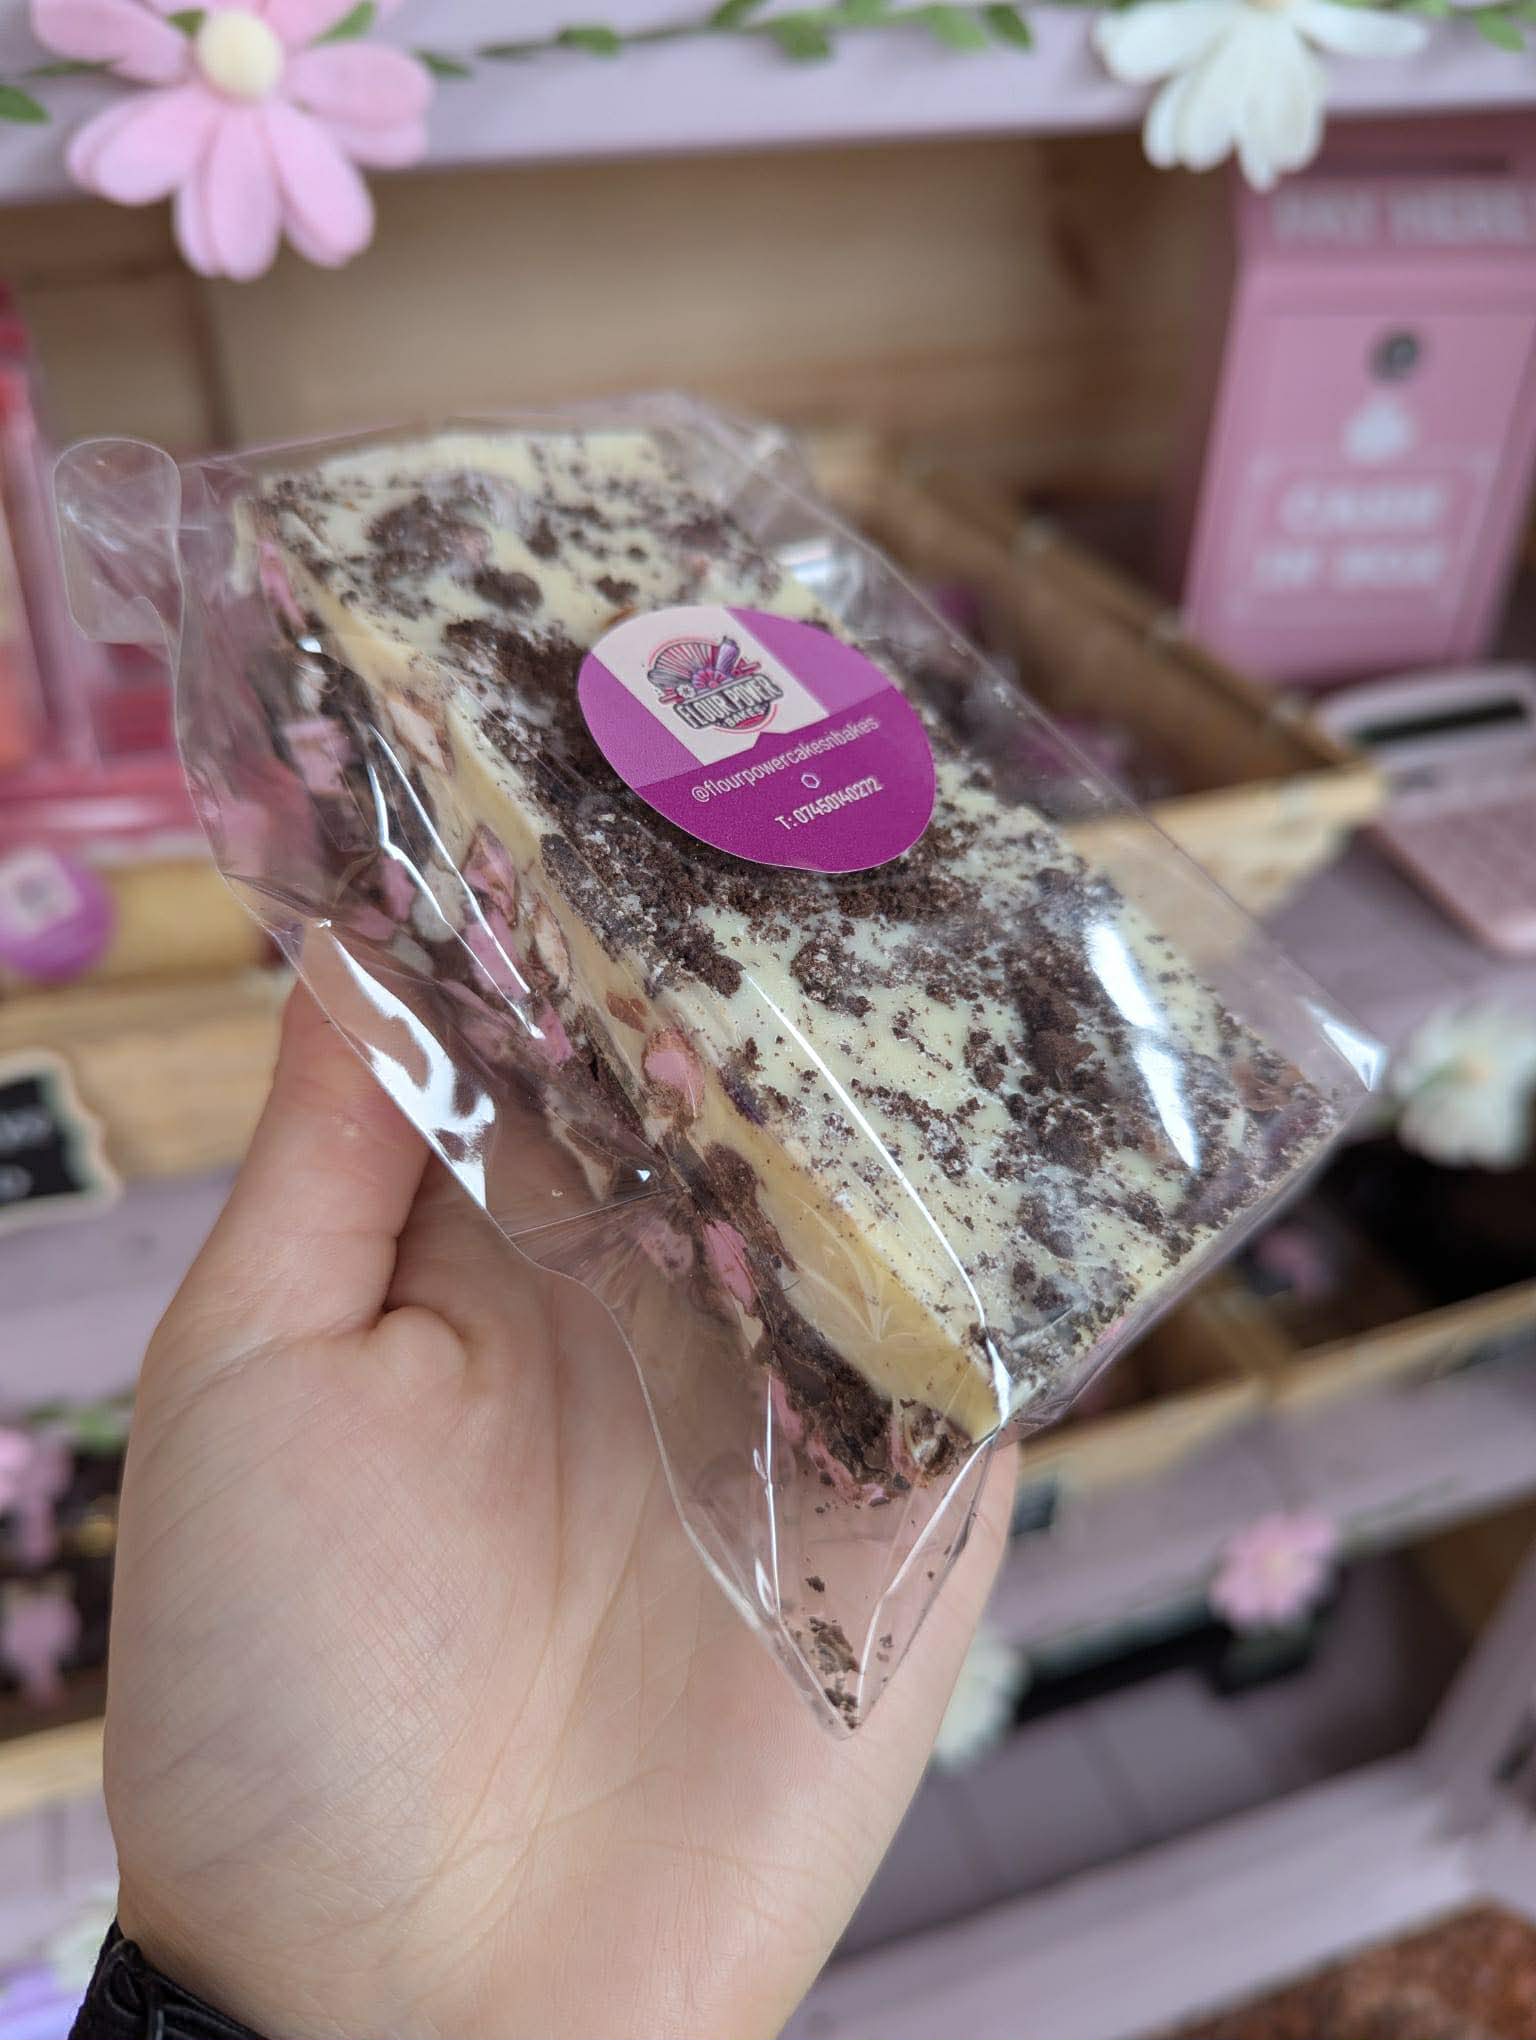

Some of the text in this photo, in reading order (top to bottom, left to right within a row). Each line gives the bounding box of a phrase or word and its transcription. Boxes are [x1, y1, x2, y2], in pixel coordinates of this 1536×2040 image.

[675, 675, 781, 729] FLOUR POWER
[724, 704, 766, 728] BAKES
[691, 717, 880, 803] @flourpowercakesnbakes
